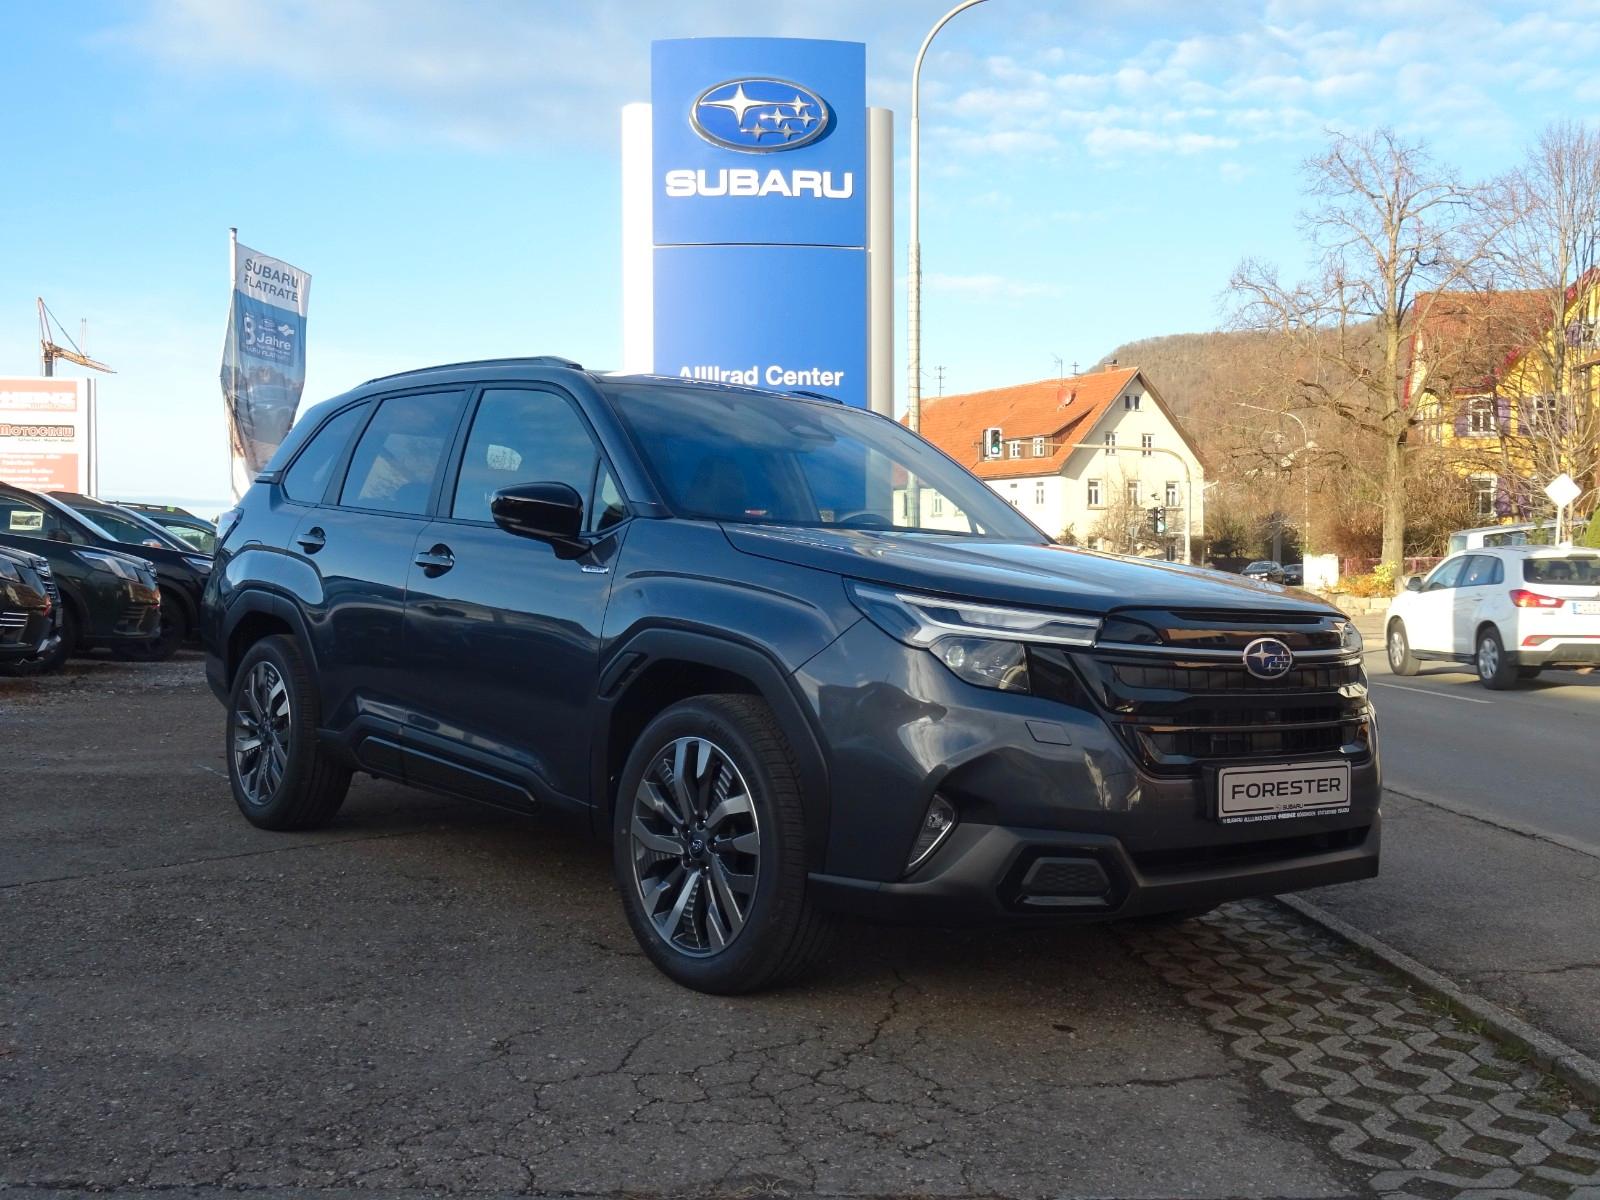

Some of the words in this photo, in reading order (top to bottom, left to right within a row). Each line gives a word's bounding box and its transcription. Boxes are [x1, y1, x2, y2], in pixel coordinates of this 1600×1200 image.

[665, 169, 853, 199] SUBARU
[245, 258, 299, 288] SUBARU
[243, 274, 299, 302] FLATRATE
[257, 333, 291, 351] Jahre
[765, 365, 844, 386] Center
[1231, 777, 1341, 800] FORESTER
[1282, 803, 1304, 811] SUBARU
